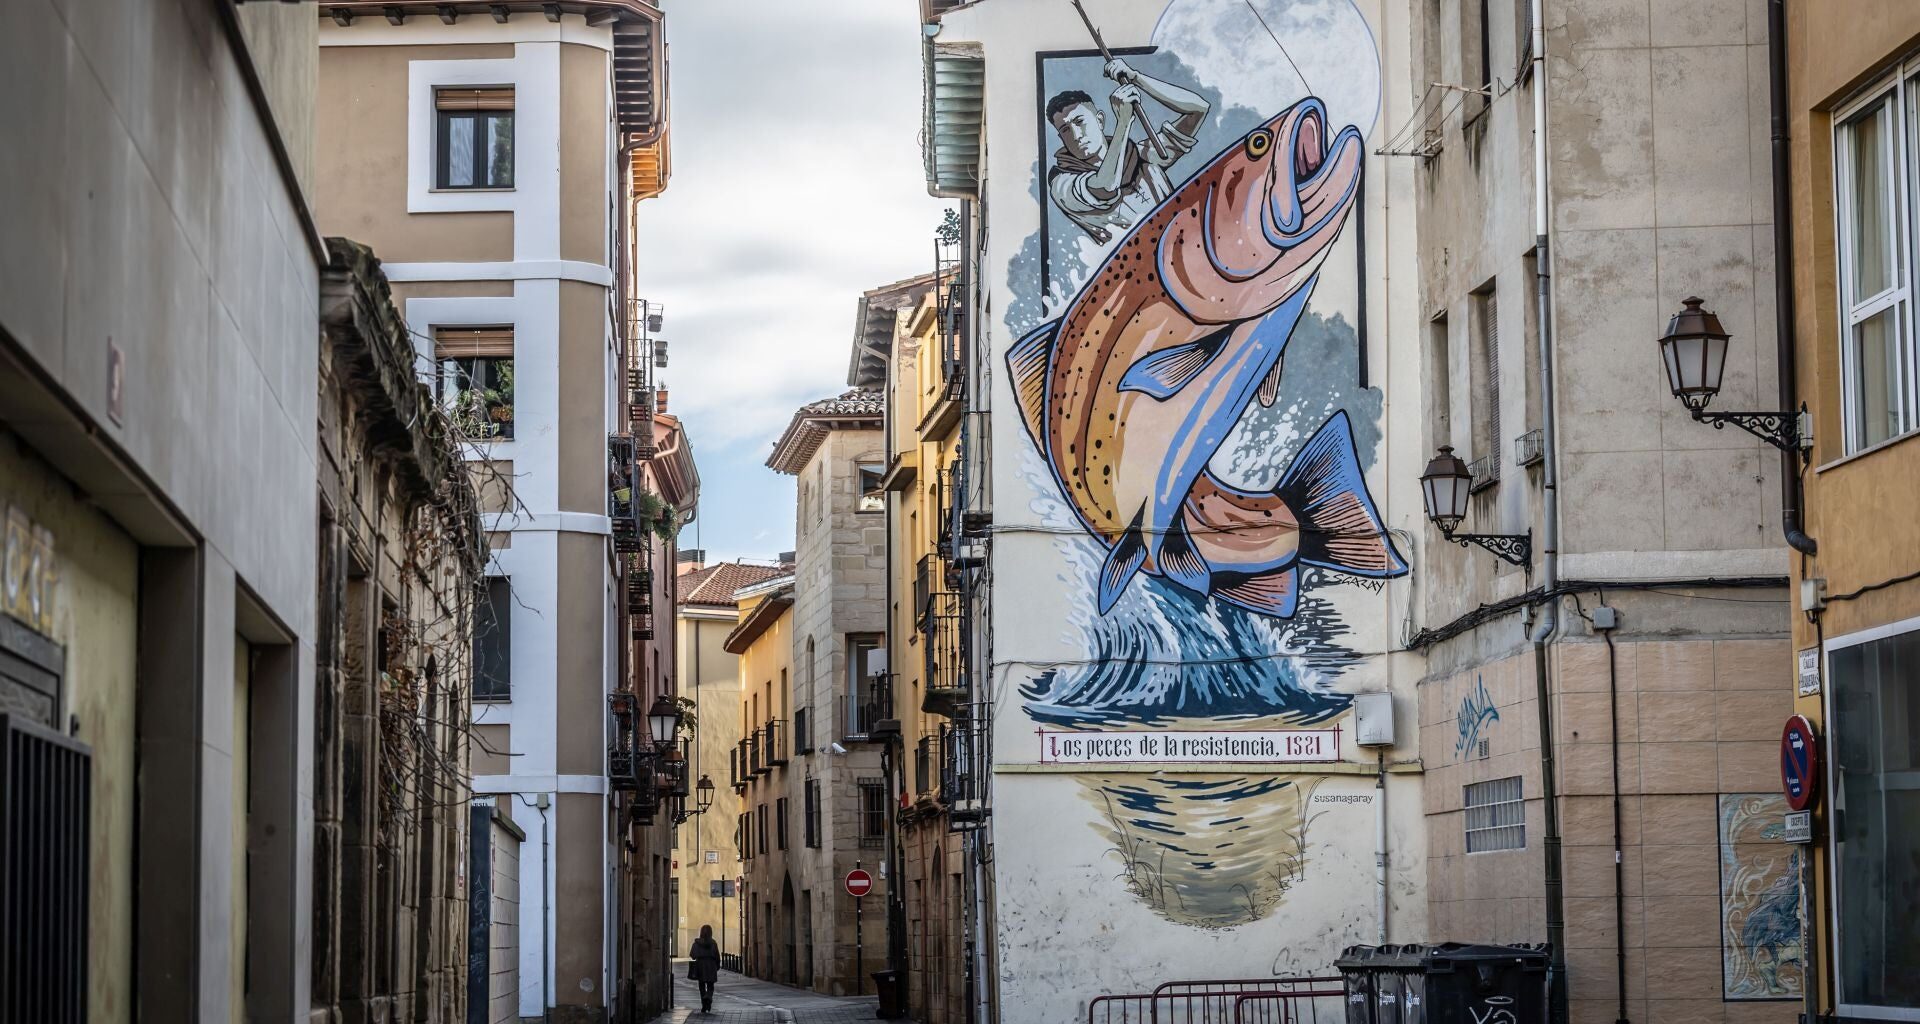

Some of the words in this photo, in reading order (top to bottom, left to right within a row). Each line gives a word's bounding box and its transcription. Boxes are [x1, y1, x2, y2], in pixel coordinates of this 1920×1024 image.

[1049, 736, 1081, 761] Los
[1087, 738, 1132, 760] peces
[1140, 736, 1158, 756] de
[1164, 736, 1177, 756] la
[1182, 736, 1280, 757] resistencia,
[1314, 794, 1373, 804] susanagaray
